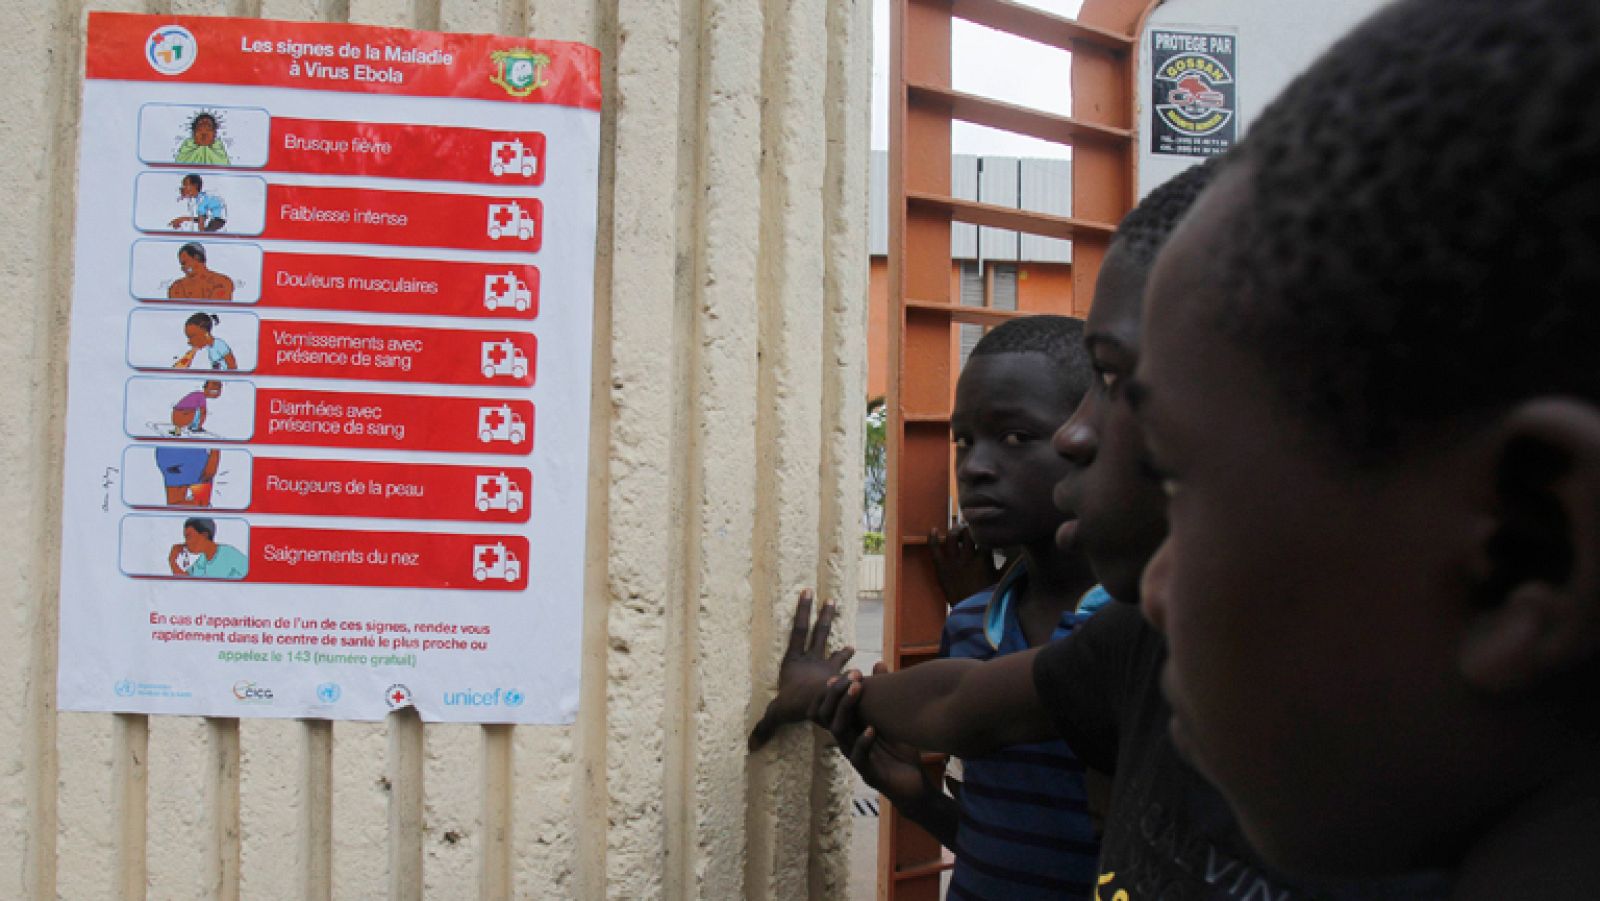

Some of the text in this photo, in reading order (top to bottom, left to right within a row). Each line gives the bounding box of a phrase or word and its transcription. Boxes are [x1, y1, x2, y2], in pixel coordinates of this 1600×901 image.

[241, 36, 453, 65] Les signes de la Maladie
[1156, 33, 1232, 54] PROTEGE PAR
[289, 60, 403, 83] à Virus Ebola
[284, 133, 392, 154] Brusque fièvre
[280, 204, 408, 226] Faiblesse intense
[276, 270, 439, 295] Douleurs musculaires
[272, 329, 424, 353] Vomissements avec
[276, 347, 412, 372] présence de sang
[270, 398, 382, 419] Diarrhées avec
[268, 417, 405, 440] présence de sang
[266, 474, 424, 499] Rougeurs de la peau
[263, 543, 420, 566] Saignements du nez
[150, 612, 167, 625] En
[169, 615, 192, 626] cas
[195, 614, 271, 629] d'apparition
[274, 616, 290, 629] de
[293, 617, 318, 629] l'un
[320, 618, 337, 631] de
[339, 620, 363, 632] ces
[414, 621, 458, 635] rendez
[460, 624, 491, 636] vous
[151, 629, 488, 651] rapidement dans le centre de santé le plus proche ou
[218, 650, 269, 662] appelez
[271, 650, 283, 662] le
[287, 650, 311, 663] 143
[314, 651, 367, 666] (numéro
[443, 687, 501, 706] unicef
